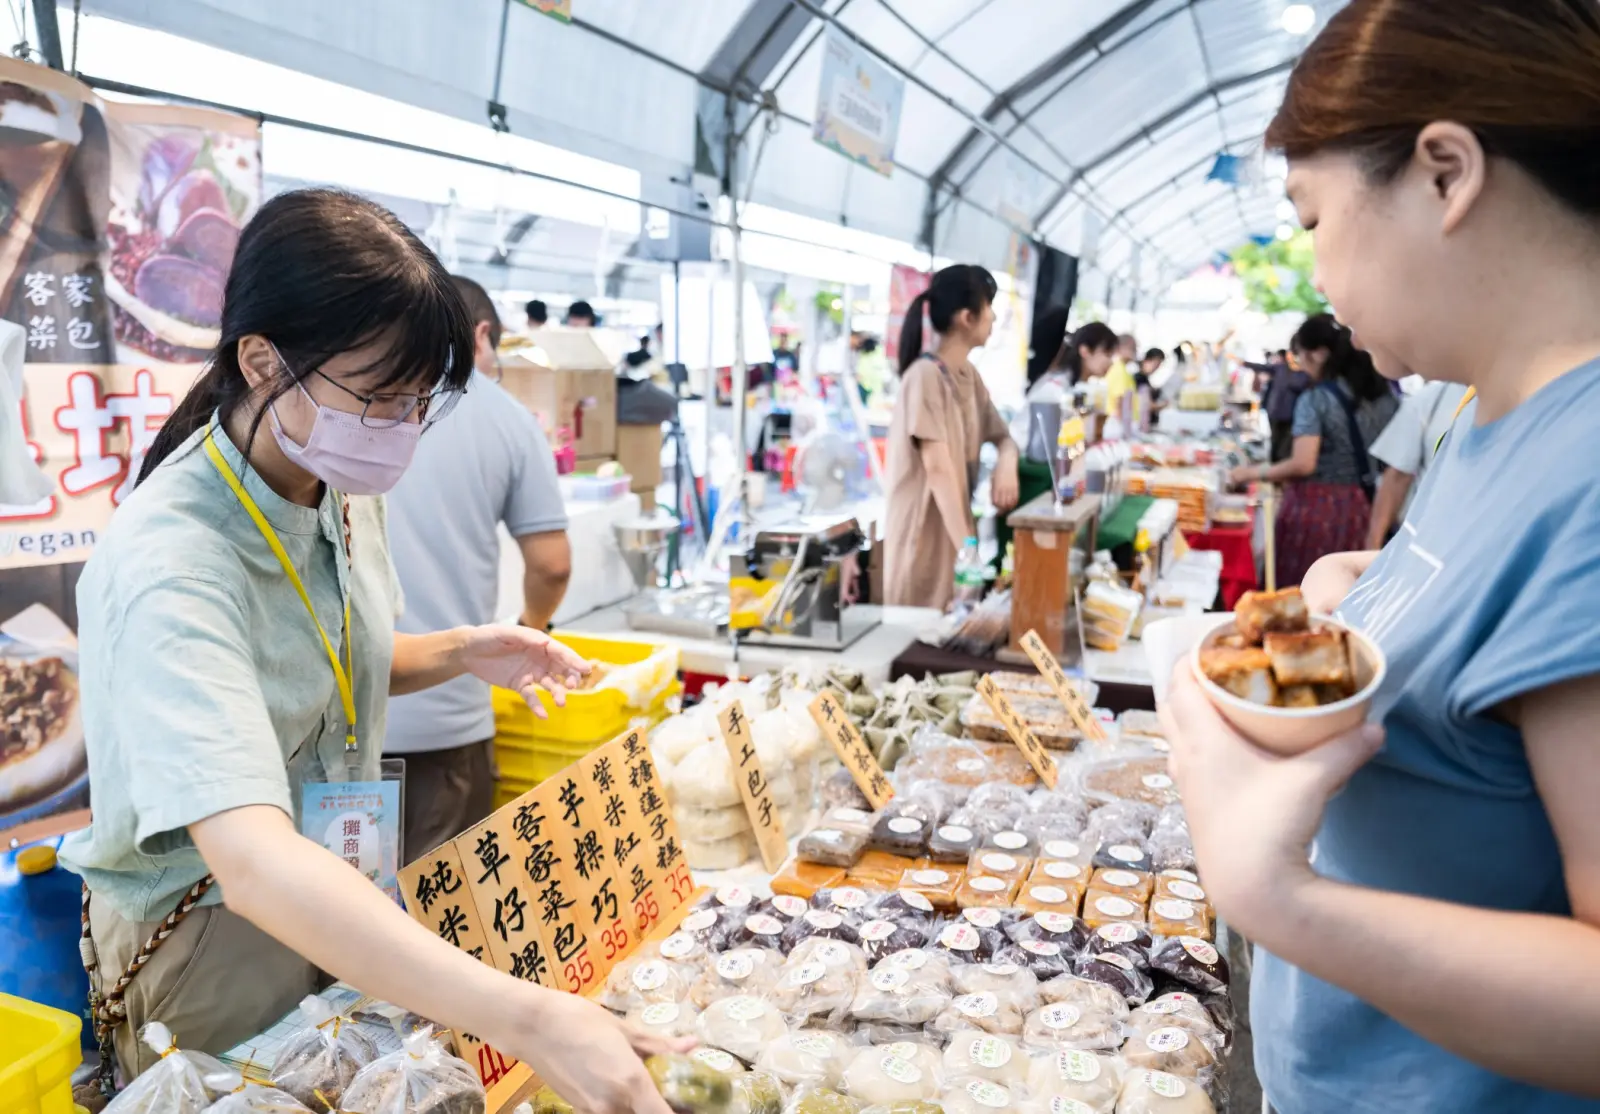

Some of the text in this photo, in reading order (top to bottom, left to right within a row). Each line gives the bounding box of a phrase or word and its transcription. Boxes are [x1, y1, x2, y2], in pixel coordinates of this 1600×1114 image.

[24, 271, 94, 307] 客家
[28, 316, 101, 350] 菜包
[9, 530, 96, 556] egan
[728, 707, 773, 827] 手工包子
[622, 732, 683, 869] 黑糖蓮子糕
[558, 778, 619, 921] 芋粿巧
[592, 756, 653, 903] 紫米紅豆
[512, 800, 586, 963] 客家菜包
[664, 863, 693, 910] 35
[633, 890, 660, 931] 35
[600, 917, 628, 960] 35
[563, 949, 595, 994] 35
